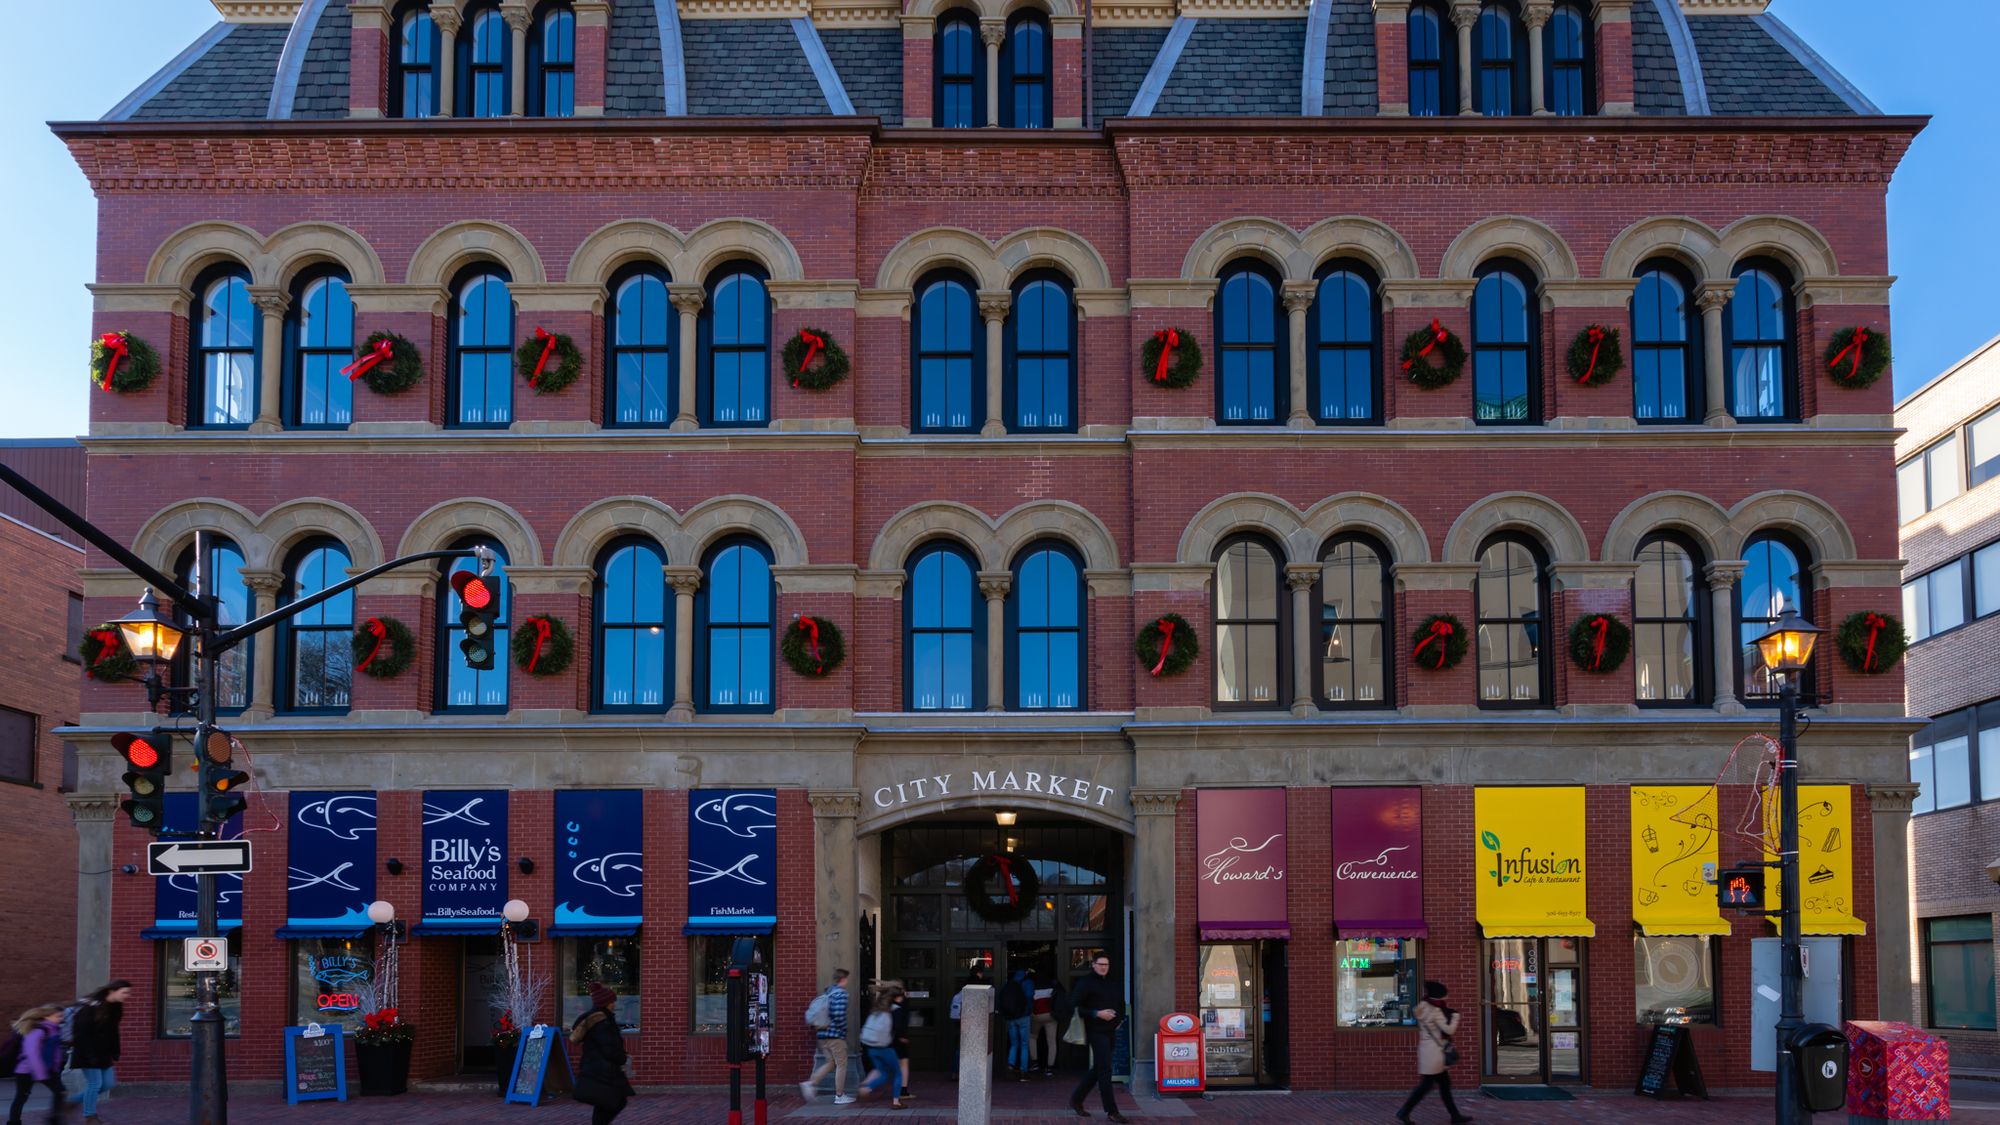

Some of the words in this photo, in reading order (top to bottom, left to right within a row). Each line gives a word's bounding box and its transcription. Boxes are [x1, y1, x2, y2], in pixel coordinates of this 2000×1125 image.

[873, 774, 952, 807] CITY
[971, 770, 1114, 807] MARKET
[428, 838, 502, 869] Billy's
[1201, 839, 1284, 884] Howard's
[1336, 853, 1418, 880] Convenience
[1496, 847, 1581, 887] Infusion
[432, 865, 497, 880] Seafood
[429, 883, 498, 891] COMPANY
[1523, 876, 1536, 886] Cafe
[711, 907, 754, 915] FishMarket
[322, 956, 358, 969] BILLY'S
[1340, 957, 1369, 968] ATM
[1492, 960, 1521, 970] OPEN
[317, 993, 359, 1007] OPEN
[1171, 1047, 1189, 1058] 649
